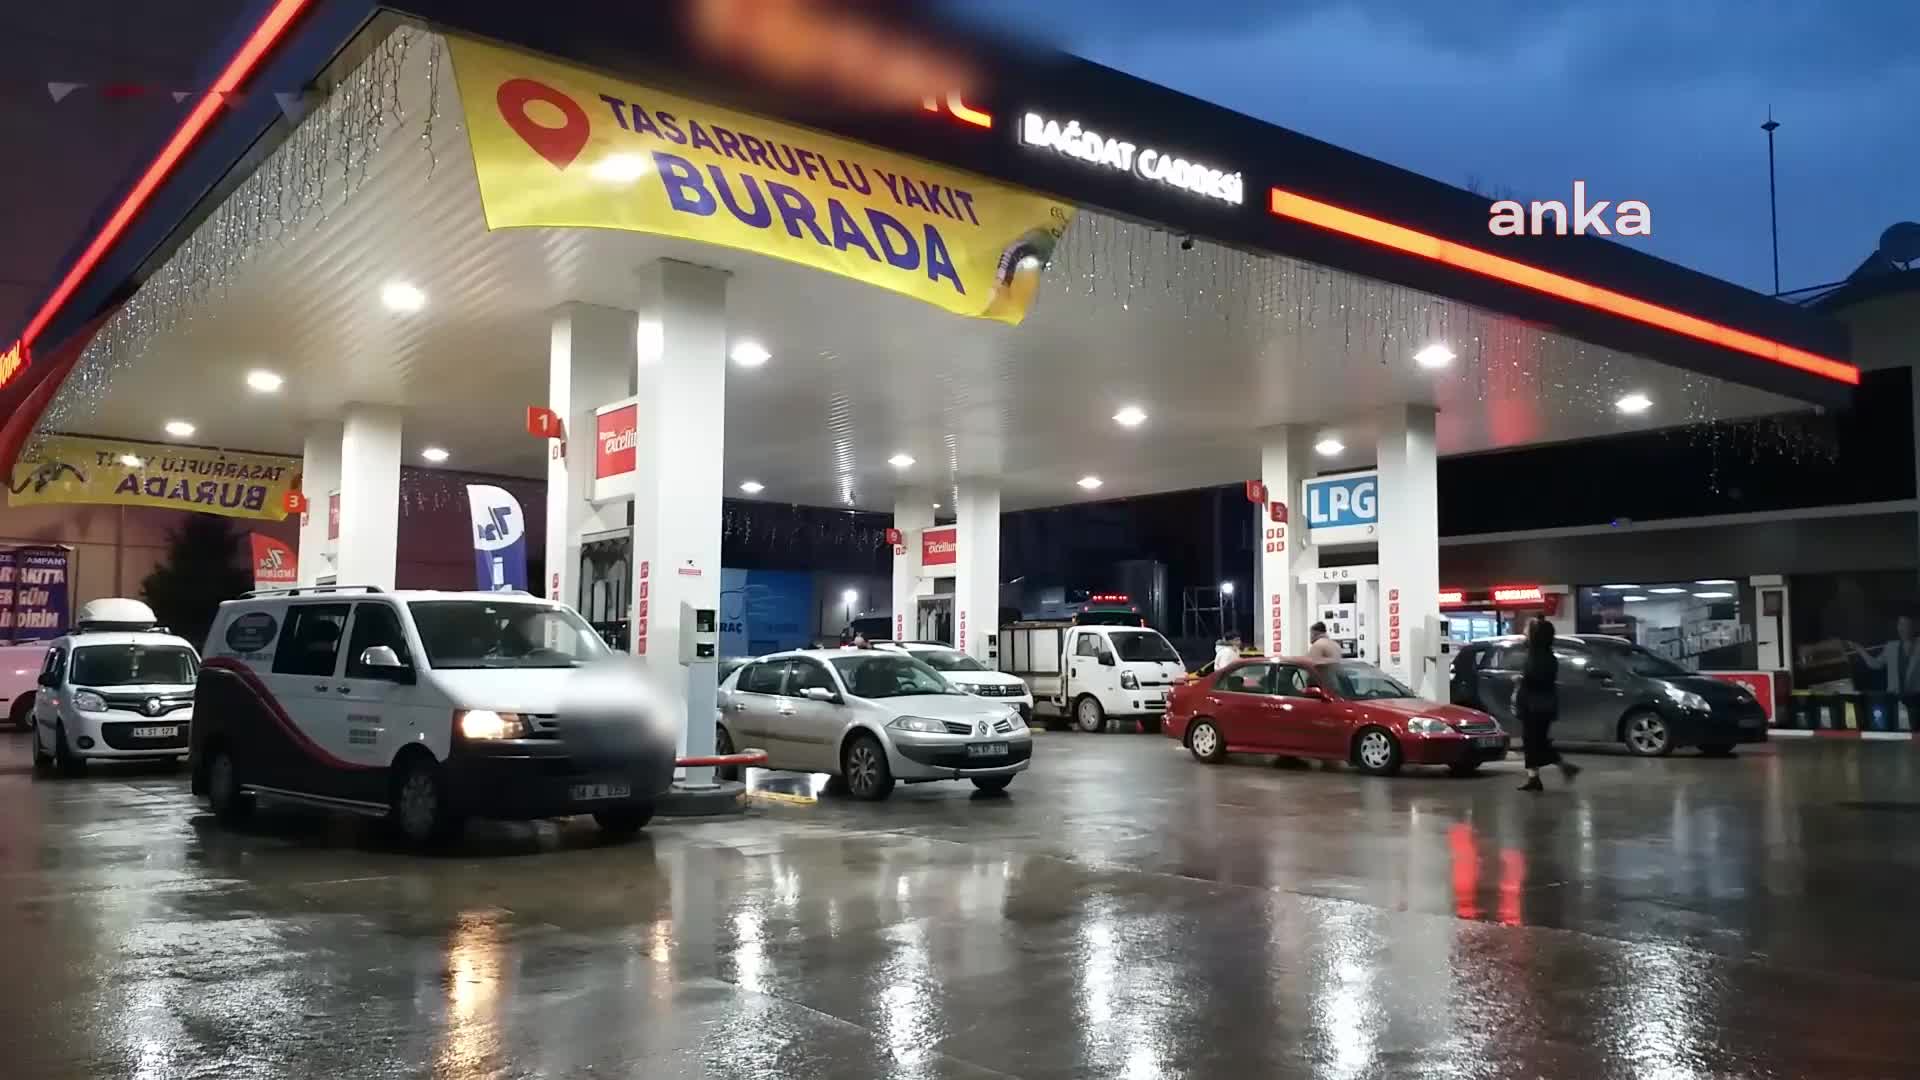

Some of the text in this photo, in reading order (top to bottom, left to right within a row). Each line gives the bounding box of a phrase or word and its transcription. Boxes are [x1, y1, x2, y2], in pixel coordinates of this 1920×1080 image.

[600, 94, 873, 196] TASARRUFLU
[873, 168, 980, 226] YAKIT
[1023, 112, 1243, 205] BAĞDAT CADDESİ
[651, 150, 966, 295] BURADA
[538, 414, 549, 432] 1
[289, 496, 298, 508] 3
[1310, 482, 1376, 524] LPG
[19, 586, 49, 606] GÜN
